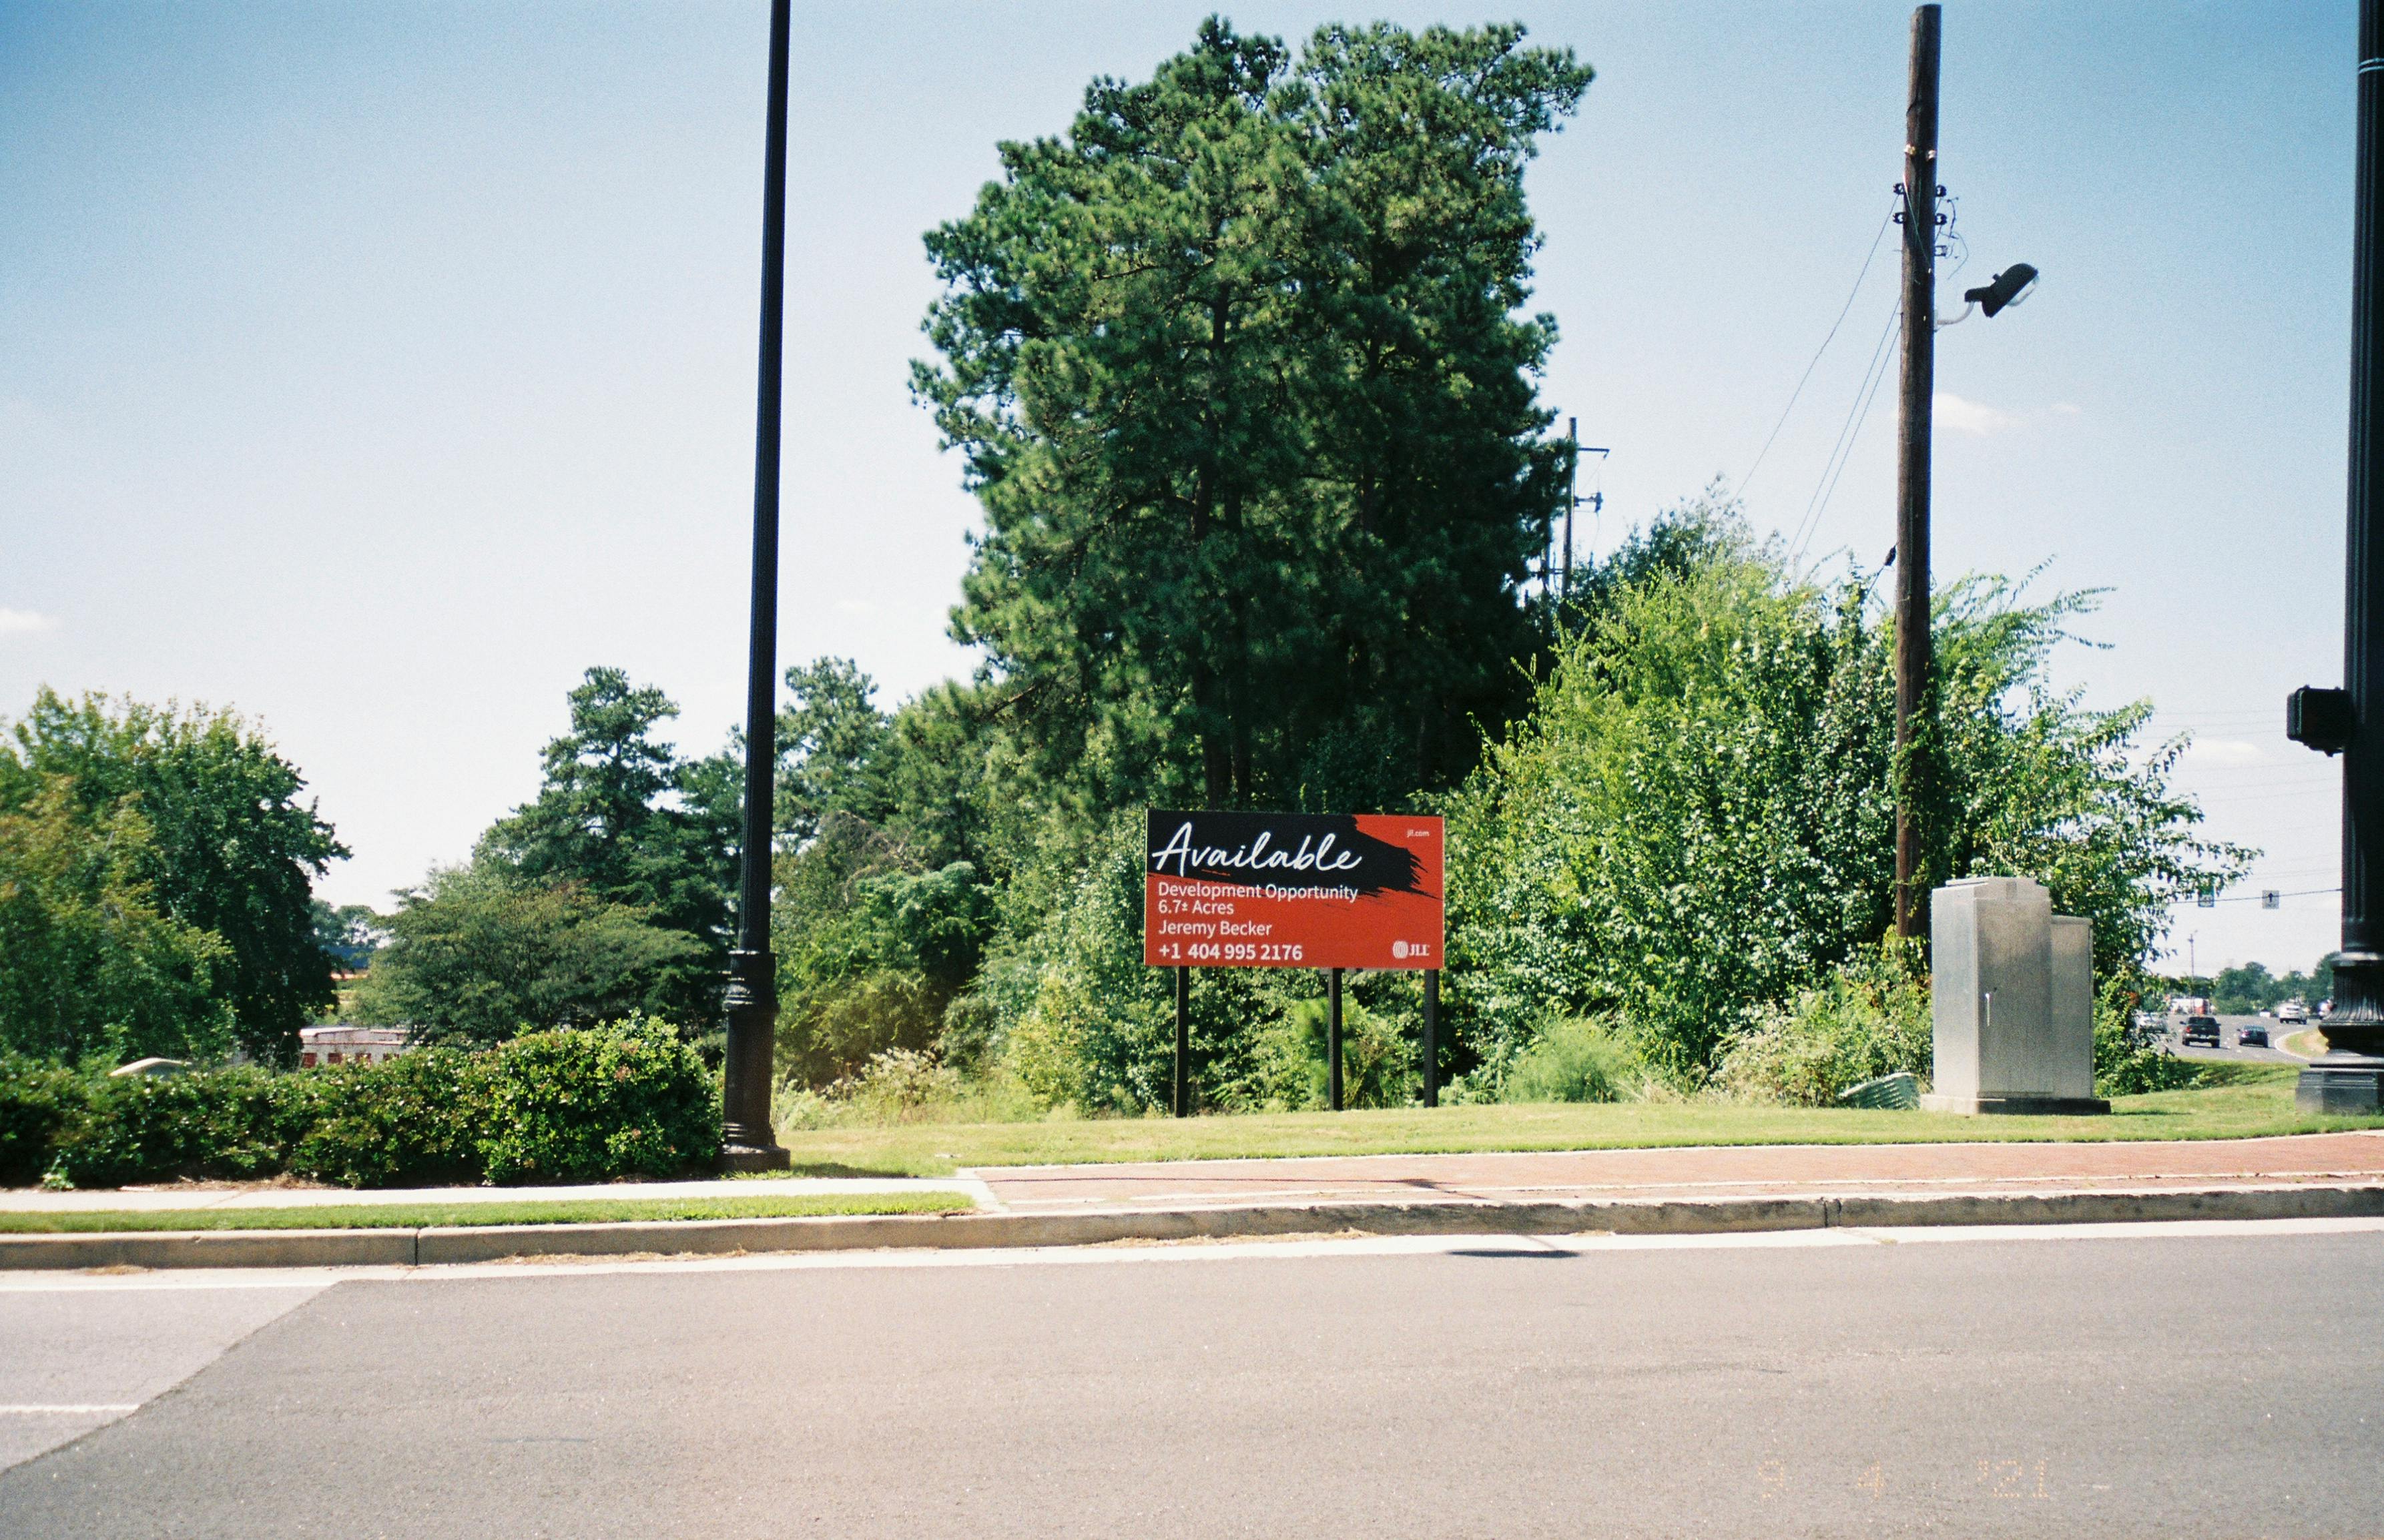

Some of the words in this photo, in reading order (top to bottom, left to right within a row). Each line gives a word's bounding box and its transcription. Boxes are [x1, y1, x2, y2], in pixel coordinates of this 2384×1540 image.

[1407, 829, 1430, 838] jll.com
[1152, 821, 1362, 877] Available
[1158, 881, 1261, 901] Development
[1265, 883, 1358, 903] Opportunity
[1191, 899, 1234, 915] Acres
[1159, 919, 1214, 939] Jeremy
[1219, 920, 1272, 936] Becker
[1159, 943, 1181, 959] +1
[1187, 943, 1221, 960] 404
[1224, 943, 1256, 960] 995
[1260, 943, 1303, 961] 2176
[1409, 943, 1430, 957] JLL
